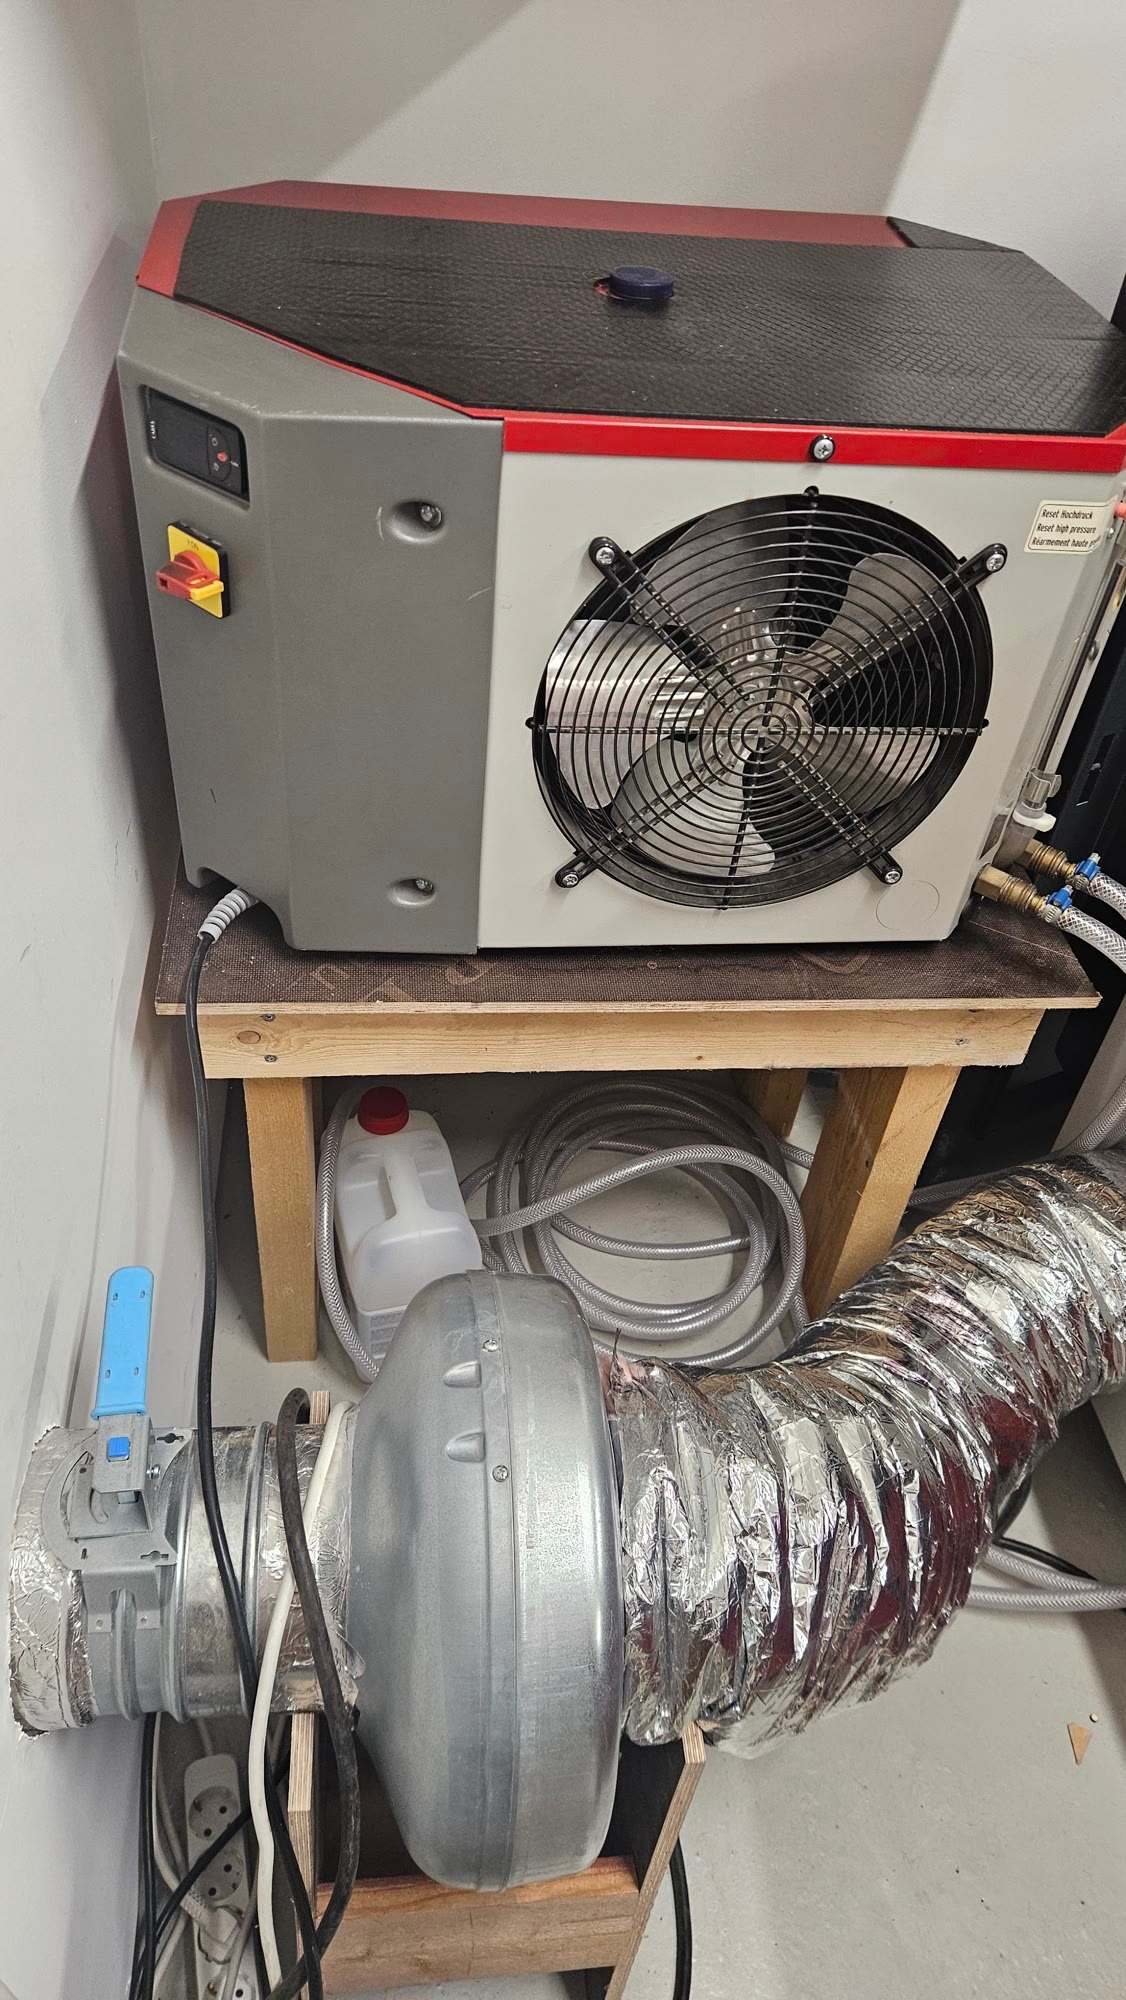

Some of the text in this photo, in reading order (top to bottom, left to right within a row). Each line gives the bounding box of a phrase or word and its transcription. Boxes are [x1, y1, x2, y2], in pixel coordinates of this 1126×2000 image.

[1042, 509, 1093, 520] Reset Hochdruck
[1037, 523, 1097, 535] Reset high pressure
[1070, 538, 1089, 548] haute
